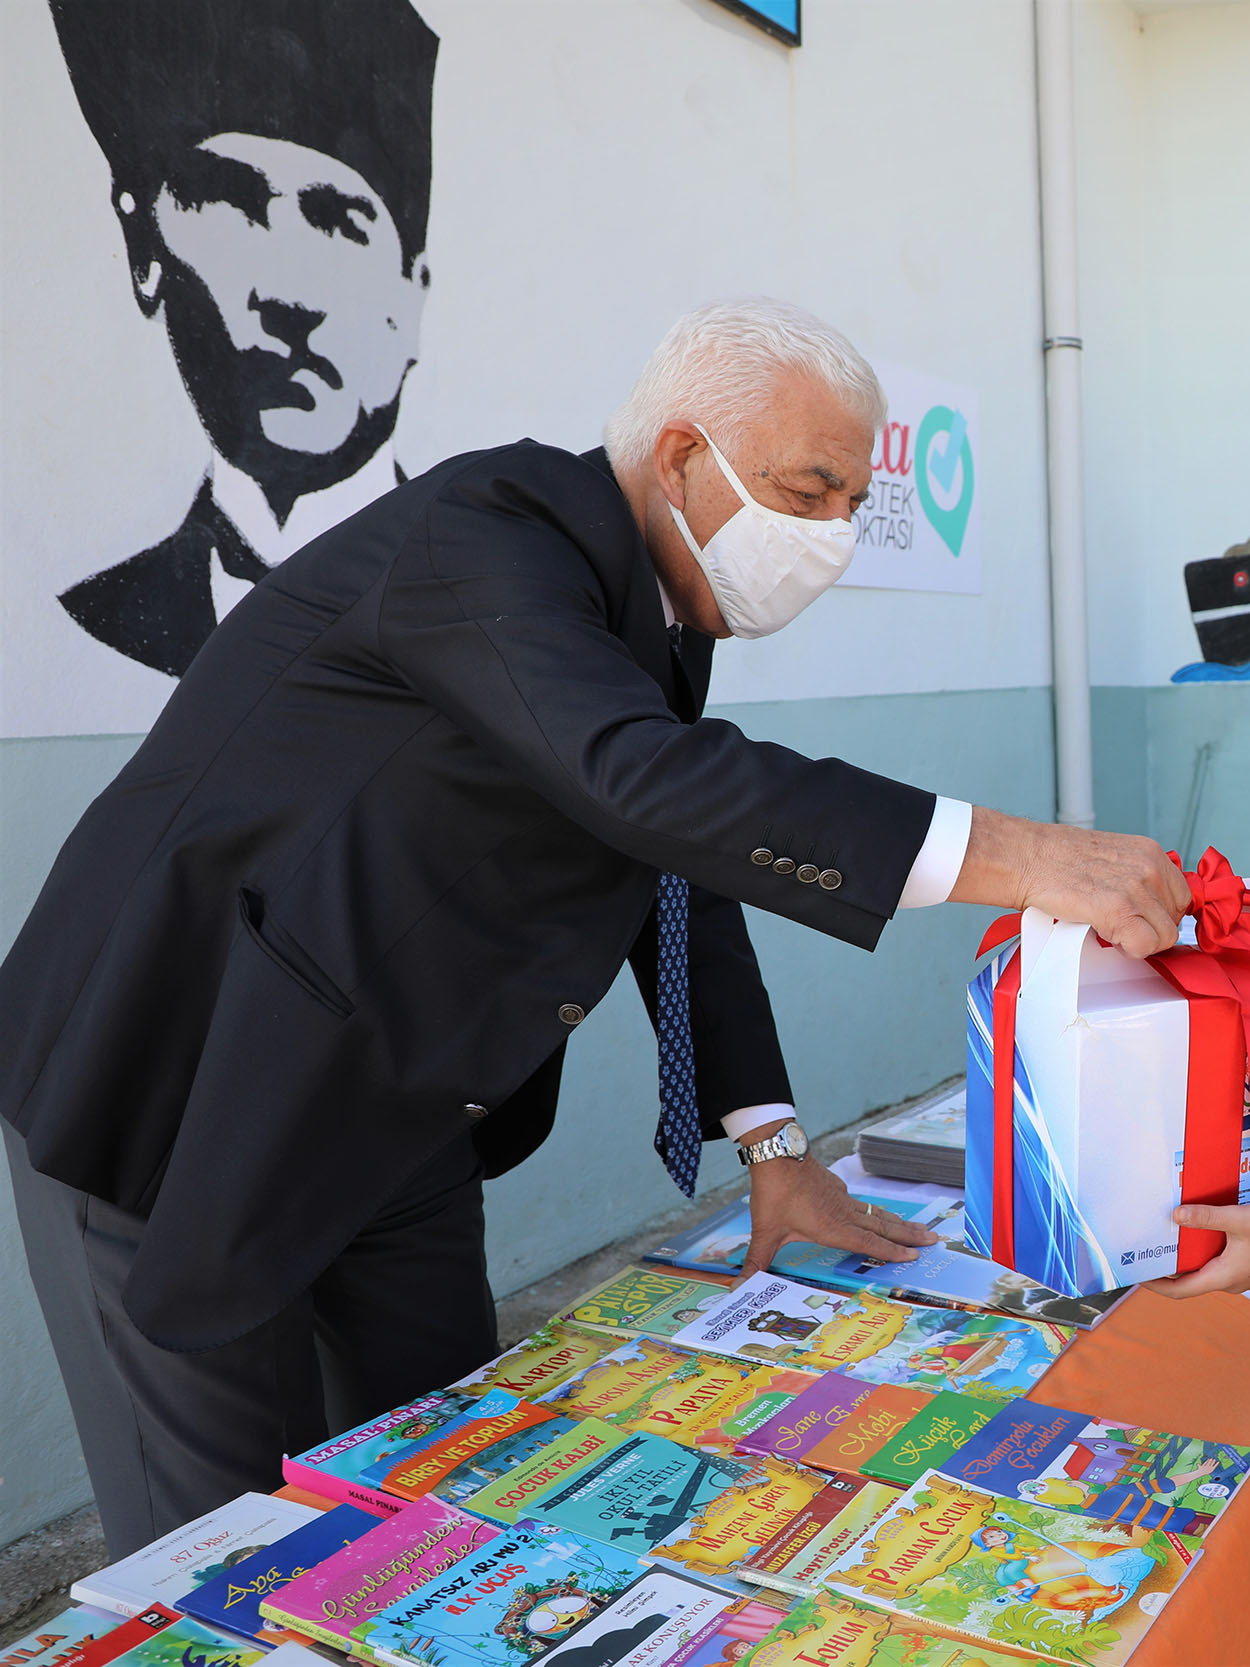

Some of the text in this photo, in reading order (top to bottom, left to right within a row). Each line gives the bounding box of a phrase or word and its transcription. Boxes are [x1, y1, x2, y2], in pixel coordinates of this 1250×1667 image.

[1137, 1243, 1178, 1261] info@mu
[622, 1274, 688, 1315] SPOR
[858, 1312, 895, 1329] ADA
[493, 1344, 589, 1392] KARTOPU
[625, 1355, 680, 1383] ASKER
[648, 1377, 734, 1426] PAPATYA
[734, 1399, 773, 1428] Bremen
[307, 1426, 380, 1465] MASAL
[395, 1458, 448, 1488] BİREY
[438, 1446, 470, 1462] VE
[458, 1409, 529, 1449] TOPLUM
[775, 1410, 822, 1451] Jane
[839, 1409, 897, 1456] Mobi
[893, 1416, 957, 1466] Küçük
[961, 1419, 1036, 1481] Demiryolu
[494, 1467, 560, 1509] ÇOCUK
[550, 1434, 607, 1471] KALBİ
[569, 1477, 606, 1502] JULES
[601, 1452, 642, 1478] VERNE
[597, 1484, 629, 1502] İKİ
[623, 1469, 655, 1485] YIL
[598, 1493, 643, 1520] OKUL
[637, 1460, 688, 1492] TATİLİ
[695, 1510, 760, 1553] MAHZENE
[747, 1483, 792, 1513] GİREN
[741, 1507, 799, 1546] GELİNCİK
[866, 1535, 940, 1586] PARMAK
[919, 1499, 975, 1537] ÇOCUK
[169, 1549, 194, 1565] 87
[193, 1531, 235, 1552] Oğuz
[314, 1517, 463, 1623] Günlüğünden
[763, 1532, 802, 1573] MUZAFFER
[797, 1521, 822, 1541] İZGÜ
[792, 1554, 827, 1581] Hayri
[822, 1528, 853, 1556] Potur
[389, 1576, 472, 1627] KANATSIZ
[470, 1558, 499, 1578] ARI
[516, 1534, 535, 1544] 2
[441, 1563, 529, 1616] İLK UÇUŞ
[643, 1598, 713, 1653] KONUŞUYOR
[792, 1621, 868, 1667] TOHUM
